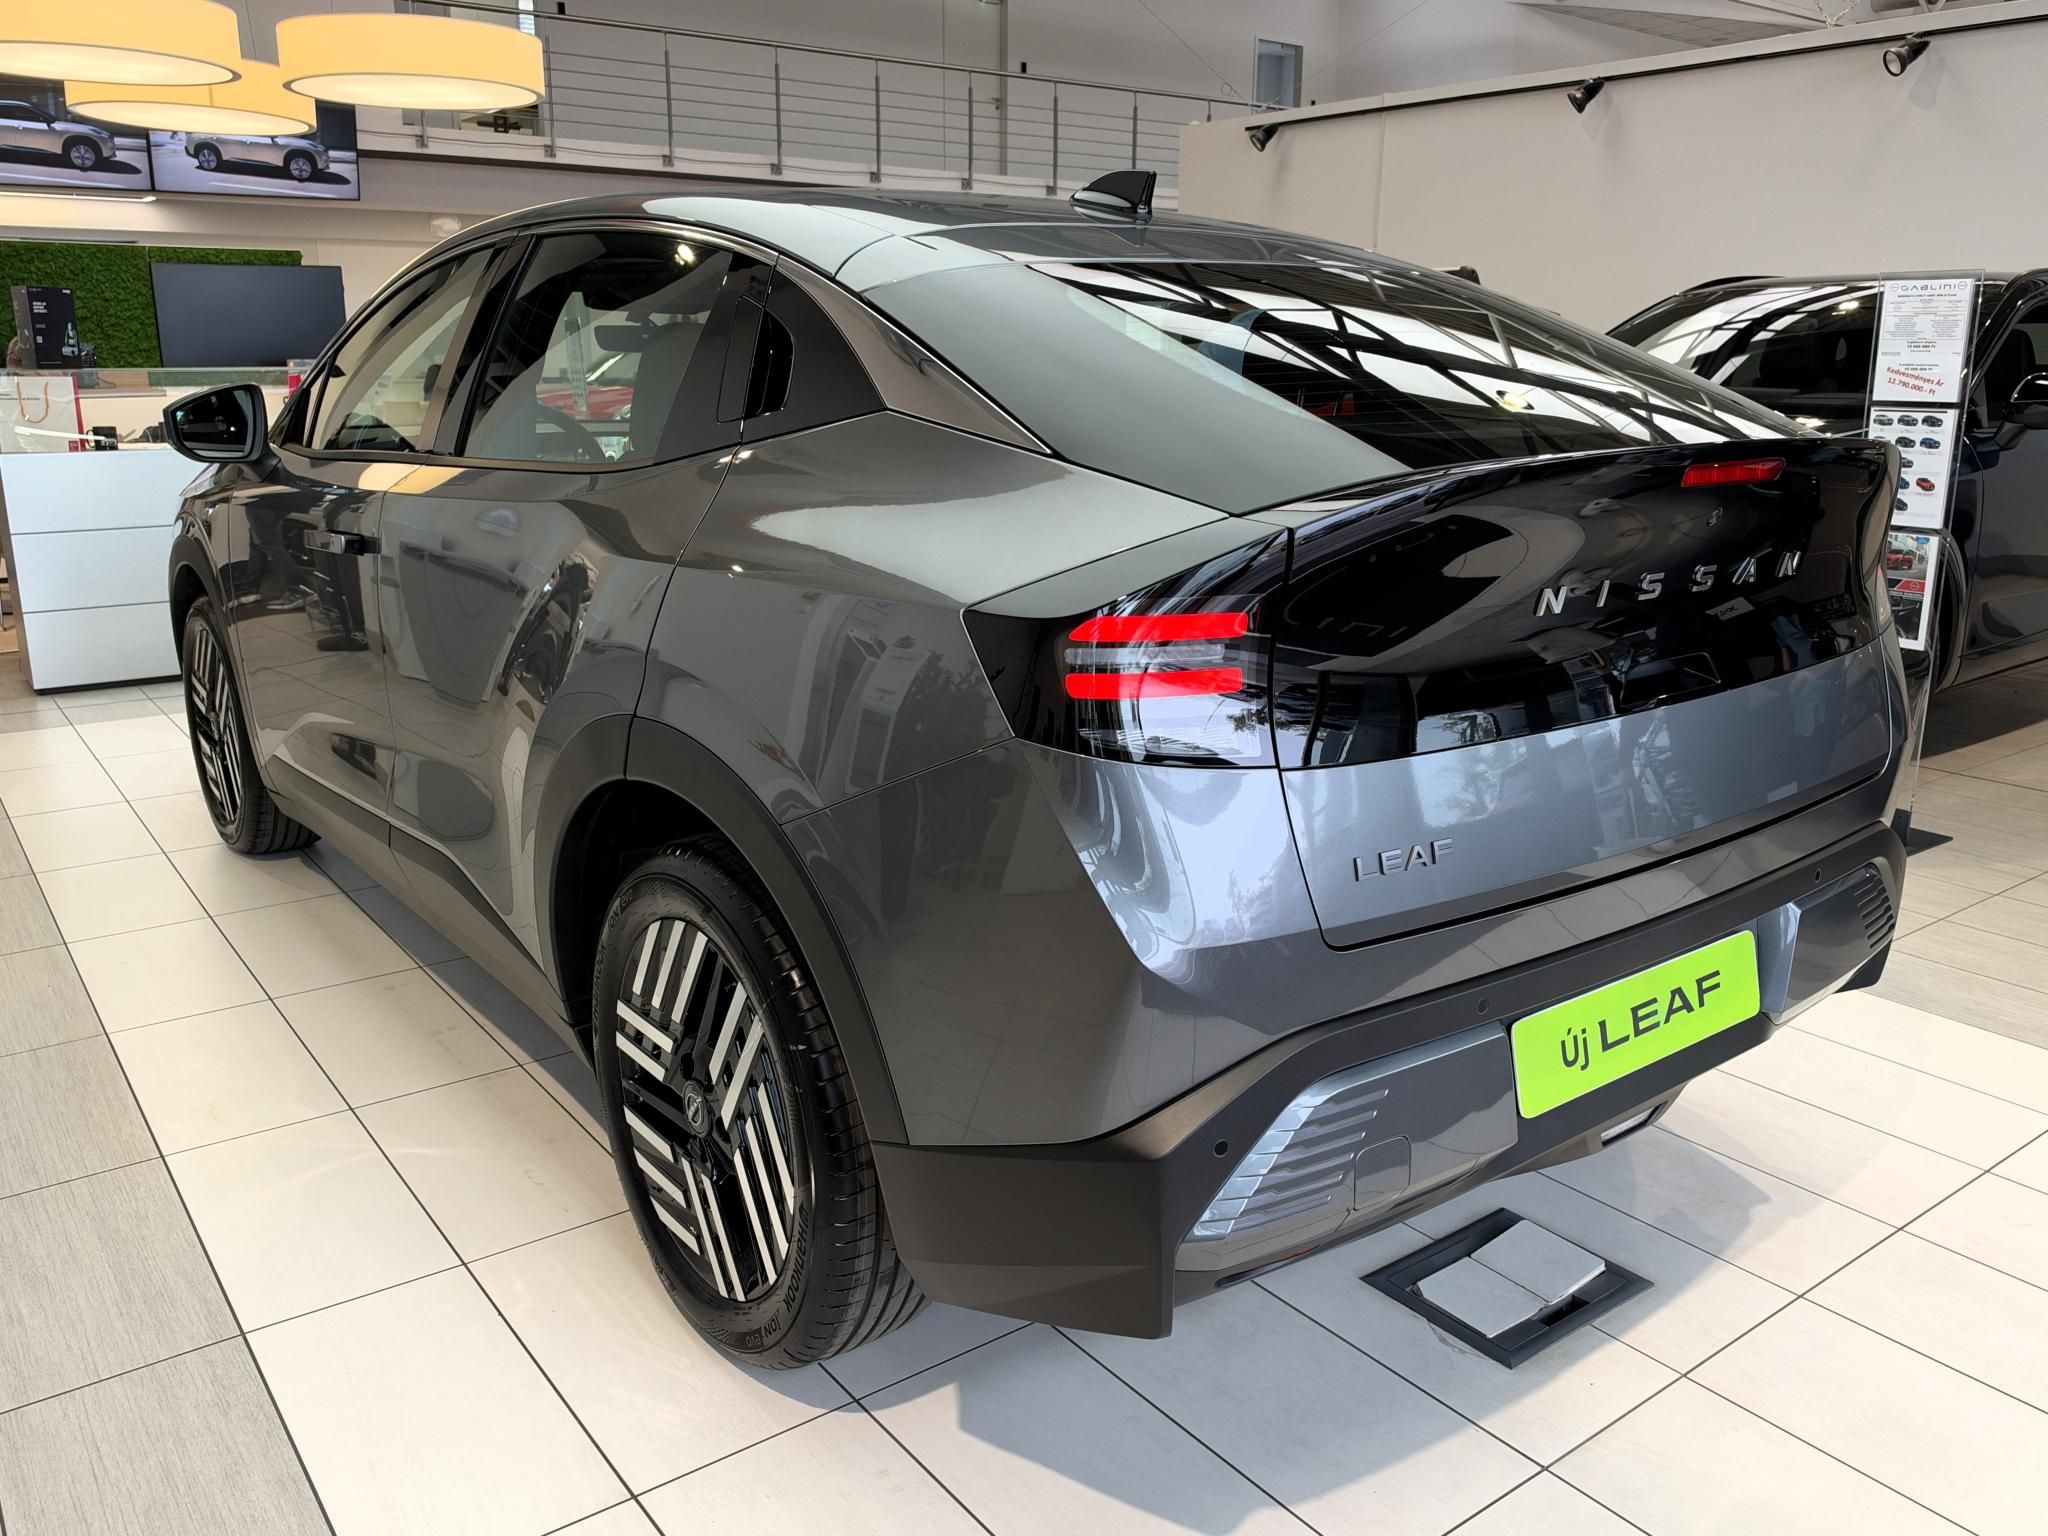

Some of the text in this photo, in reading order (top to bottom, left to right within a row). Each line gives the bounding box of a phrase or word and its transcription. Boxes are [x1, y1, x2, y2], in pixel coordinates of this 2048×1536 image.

[1901, 283, 1957, 292] GABLINI
[1887, 367, 1934, 386] Kedvezményes
[1532, 551, 1801, 617] NISSAN
[1352, 837, 1454, 882] LEAF
[1560, 969, 1721, 1071] Új LEAF
